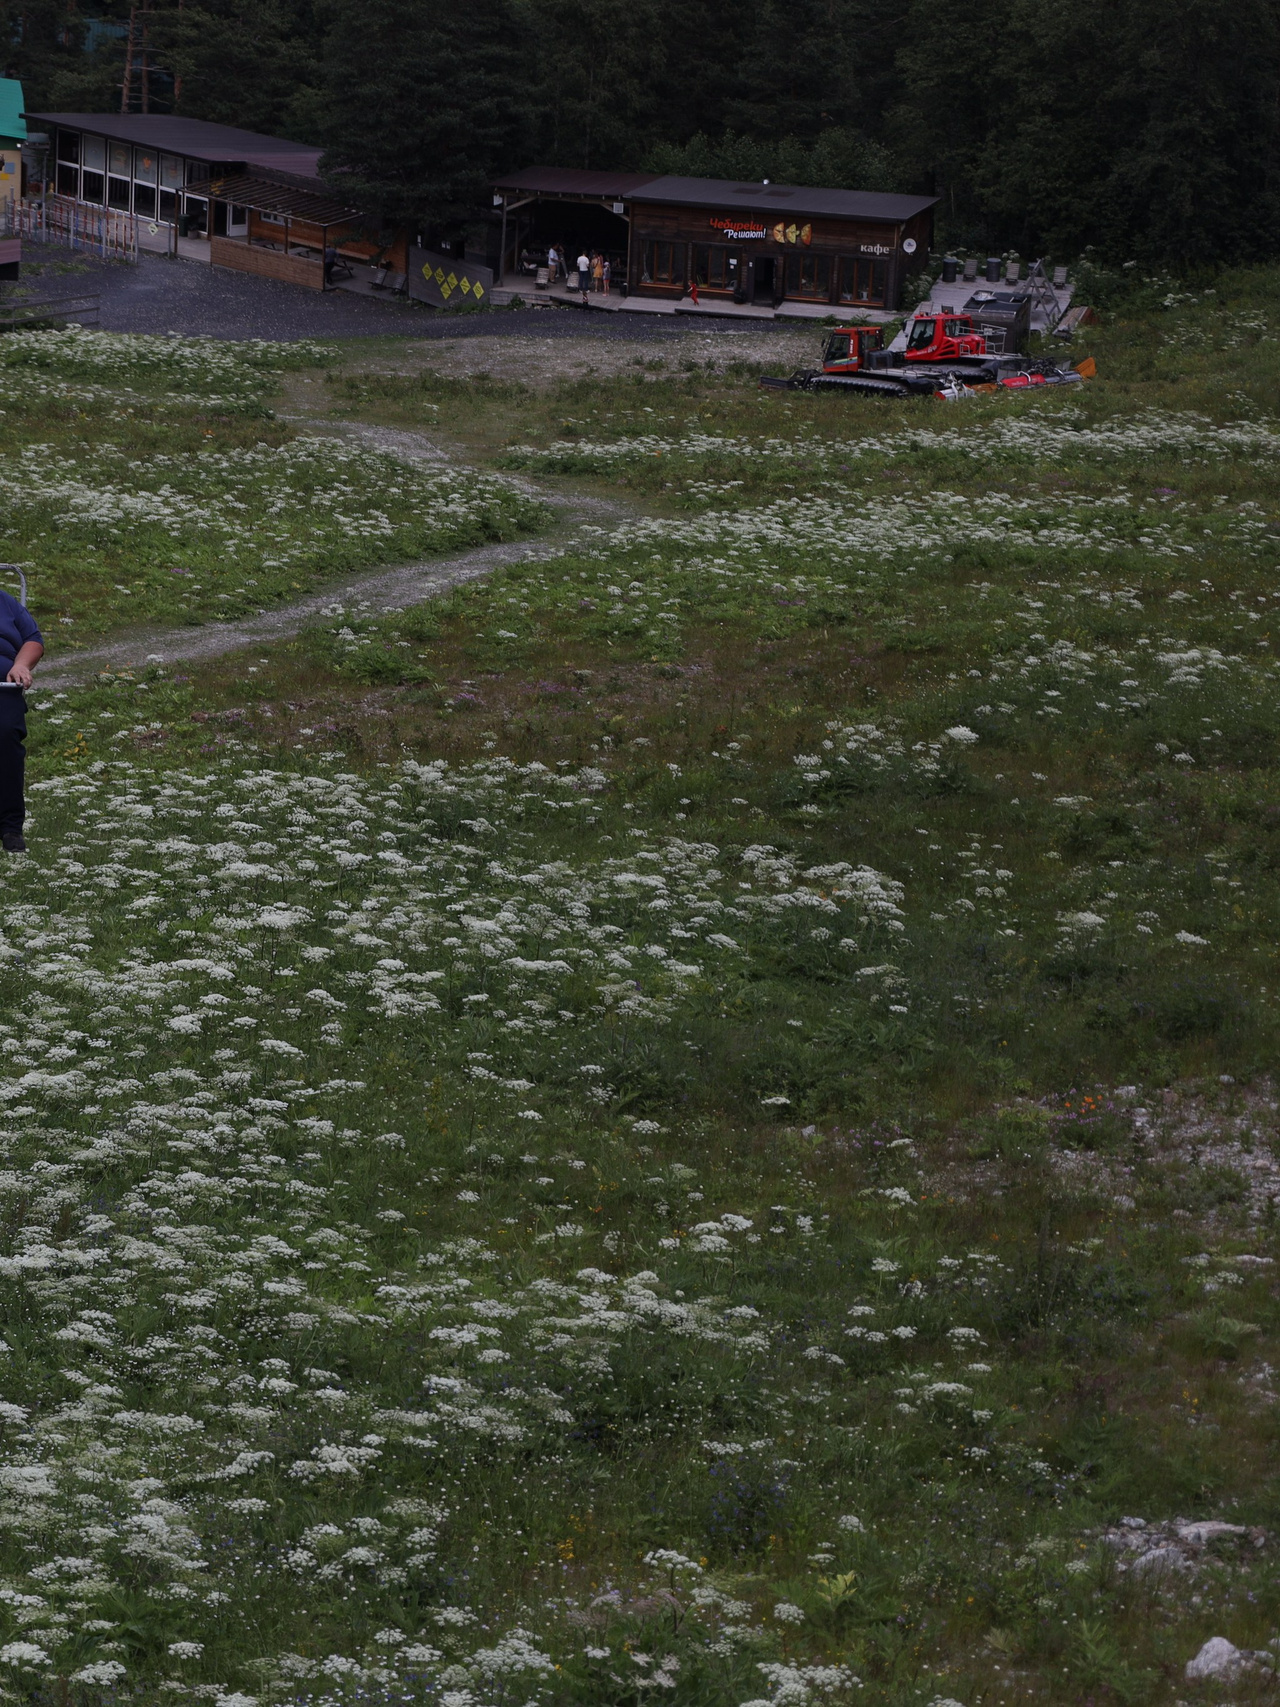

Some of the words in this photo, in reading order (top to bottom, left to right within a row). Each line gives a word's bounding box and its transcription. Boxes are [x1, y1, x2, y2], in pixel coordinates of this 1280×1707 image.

[709, 217, 765, 231] Чебуреки
[723, 228, 767, 239] Решают!
[860, 243, 890, 255] кафе
